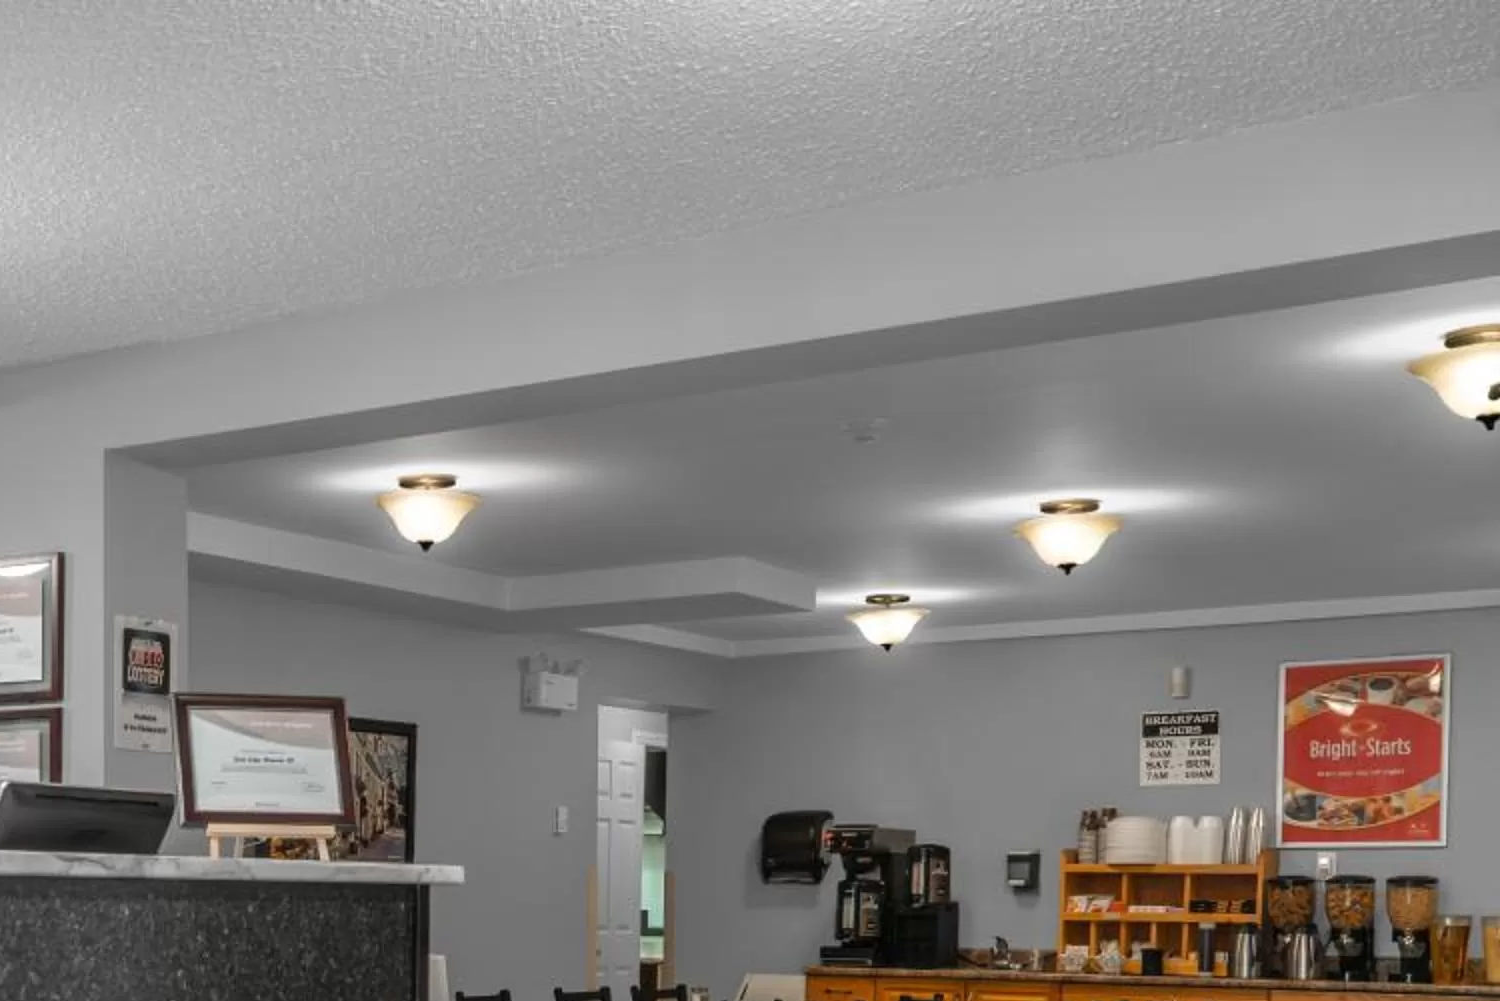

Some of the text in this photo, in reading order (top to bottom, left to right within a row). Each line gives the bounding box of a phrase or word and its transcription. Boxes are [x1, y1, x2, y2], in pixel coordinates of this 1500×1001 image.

[1145, 713, 1217, 725] BREAKFAST
[1158, 725, 1203, 736] HOURS
[1309, 736, 1412, 761] Bright Starts
